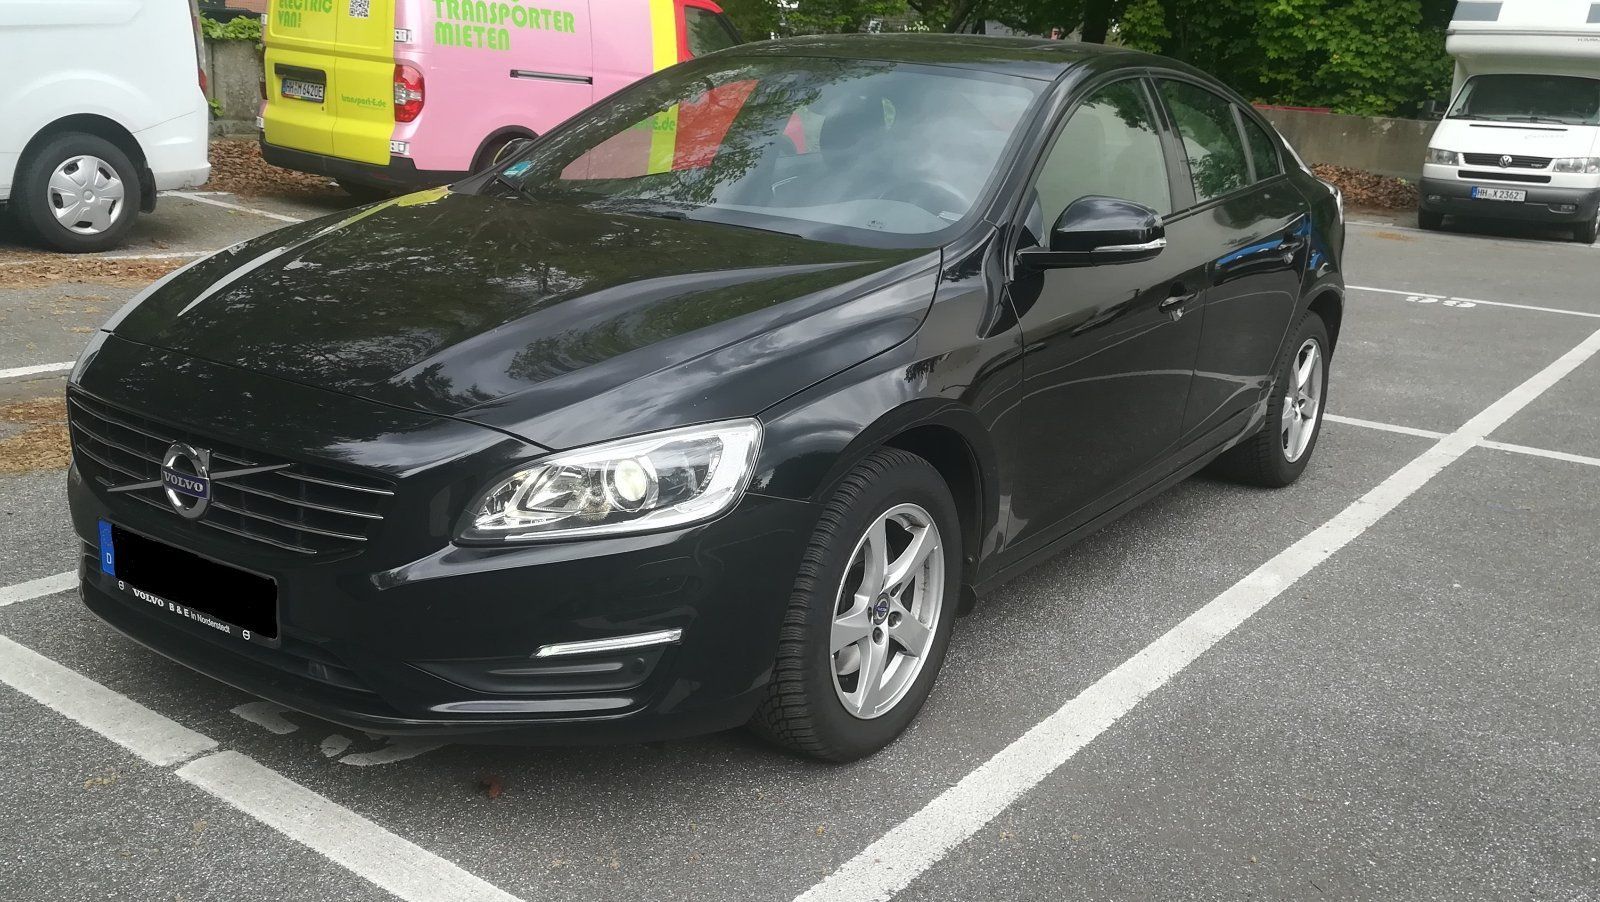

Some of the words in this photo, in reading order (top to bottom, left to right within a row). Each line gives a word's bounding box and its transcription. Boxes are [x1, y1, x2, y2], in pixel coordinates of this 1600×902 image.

[433, 0, 575, 33] TRANSPORTER
[434, 22, 511, 50] MIETEN
[1477, 188, 1488, 197] HH
[163, 471, 204, 492] VOLVO
[132, 587, 165, 607] VOLVO
[197, 613, 231, 634] Norderstedt
